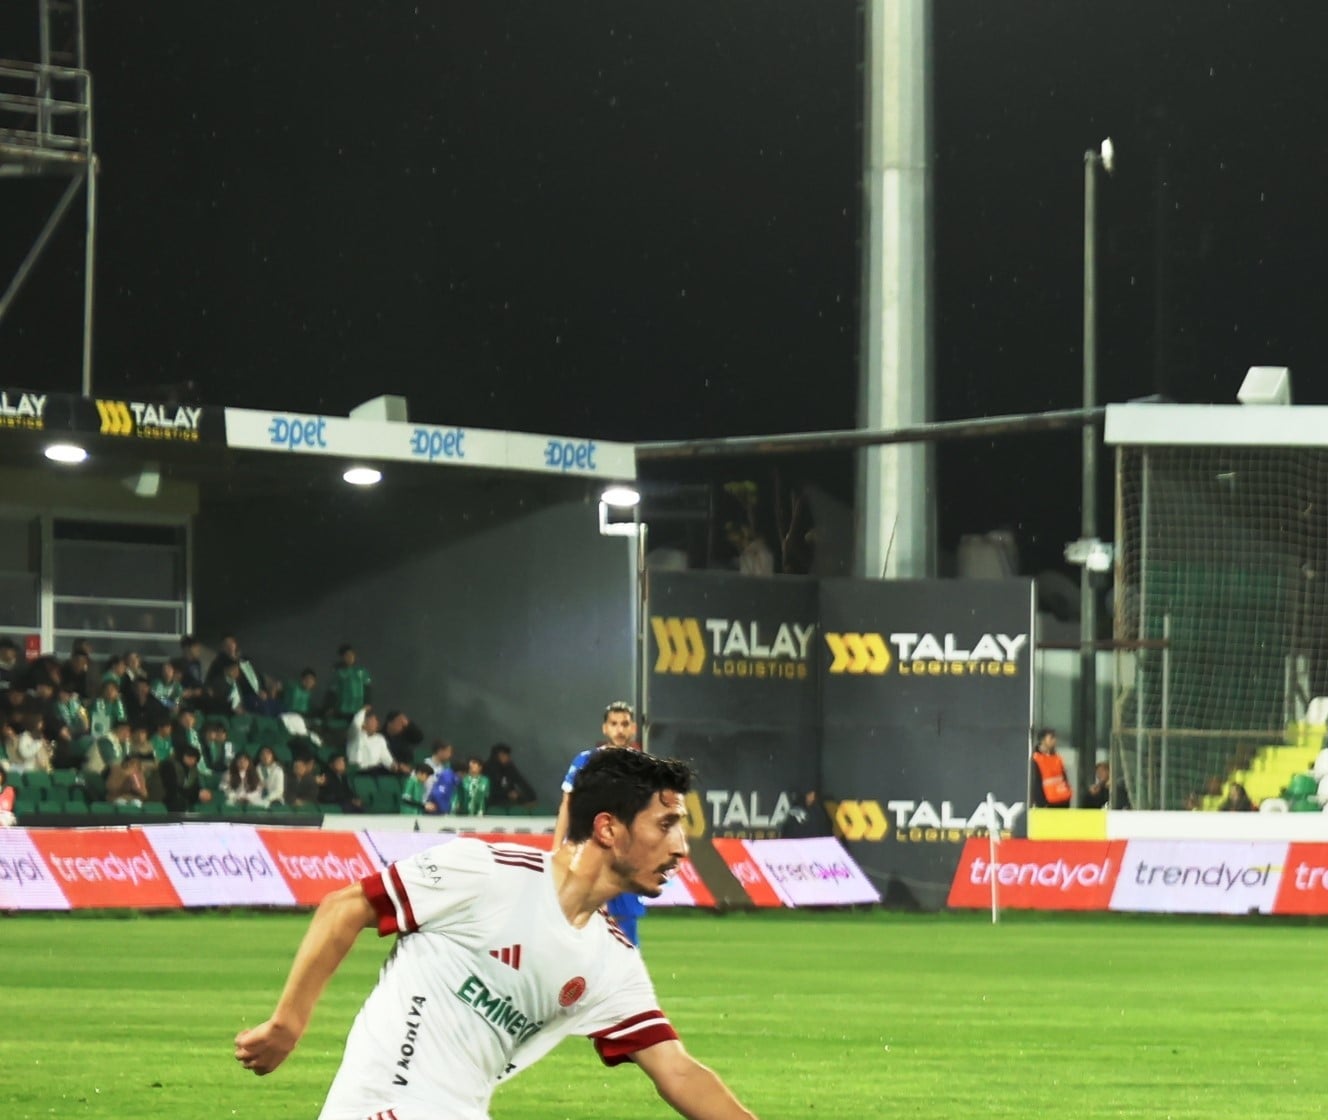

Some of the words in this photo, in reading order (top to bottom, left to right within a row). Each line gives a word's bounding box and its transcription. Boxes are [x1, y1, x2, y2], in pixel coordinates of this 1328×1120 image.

[0, 391, 47, 418] LAY
[130, 402, 202, 429] TALAY
[706, 618, 815, 659] TALAY
[890, 632, 1028, 662] TALAY
[712, 660, 808, 680] LOGISTICS
[898, 660, 1017, 677] LOGISTICS
[705, 790, 790, 828] TALA
[887, 800, 1024, 829] TALAY
[50, 848, 160, 887] trendyol
[169, 850, 274, 882] trendyol
[969, 857, 1112, 891] trendyol
[1135, 860, 1271, 892] trendyol
